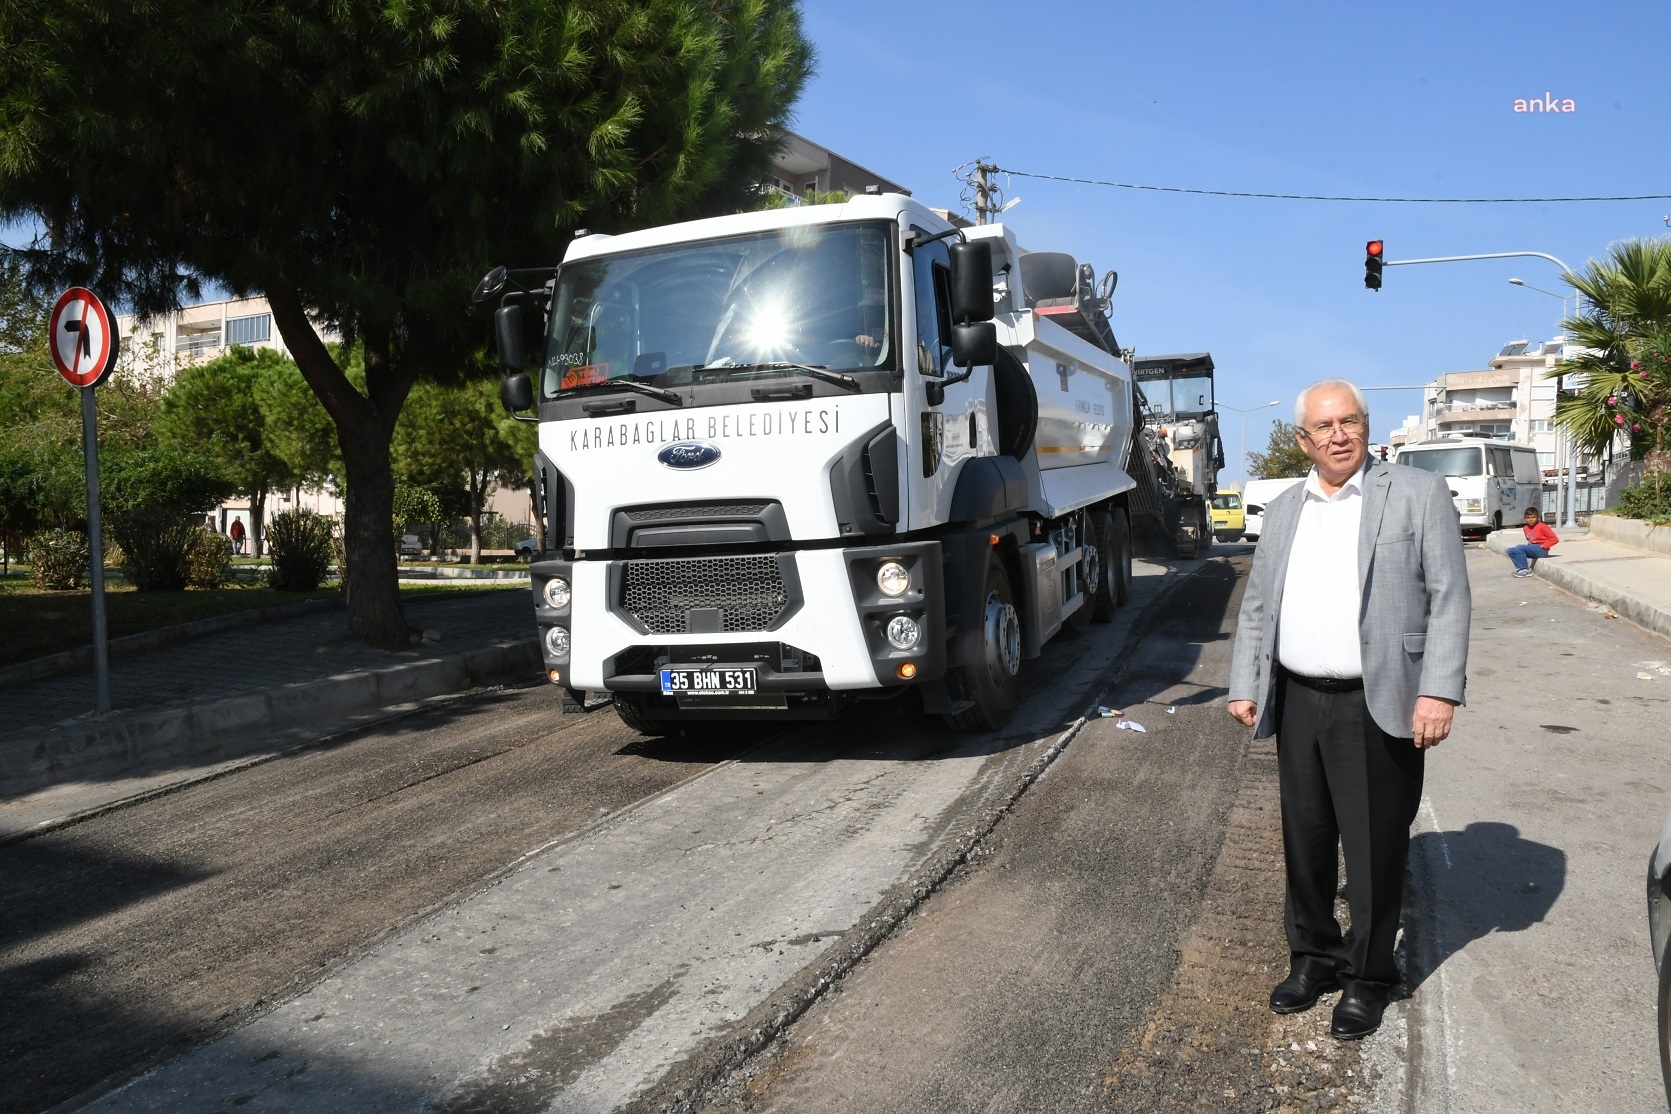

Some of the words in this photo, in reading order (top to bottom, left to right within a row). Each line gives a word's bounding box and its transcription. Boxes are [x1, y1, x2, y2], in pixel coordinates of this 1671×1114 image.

[708, 404, 839, 439] BELEDİYESİ
[670, 445, 705, 463] Ford
[671, 672, 688, 689] 35
[693, 672, 720, 689] BHN
[725, 671, 751, 689] 531
